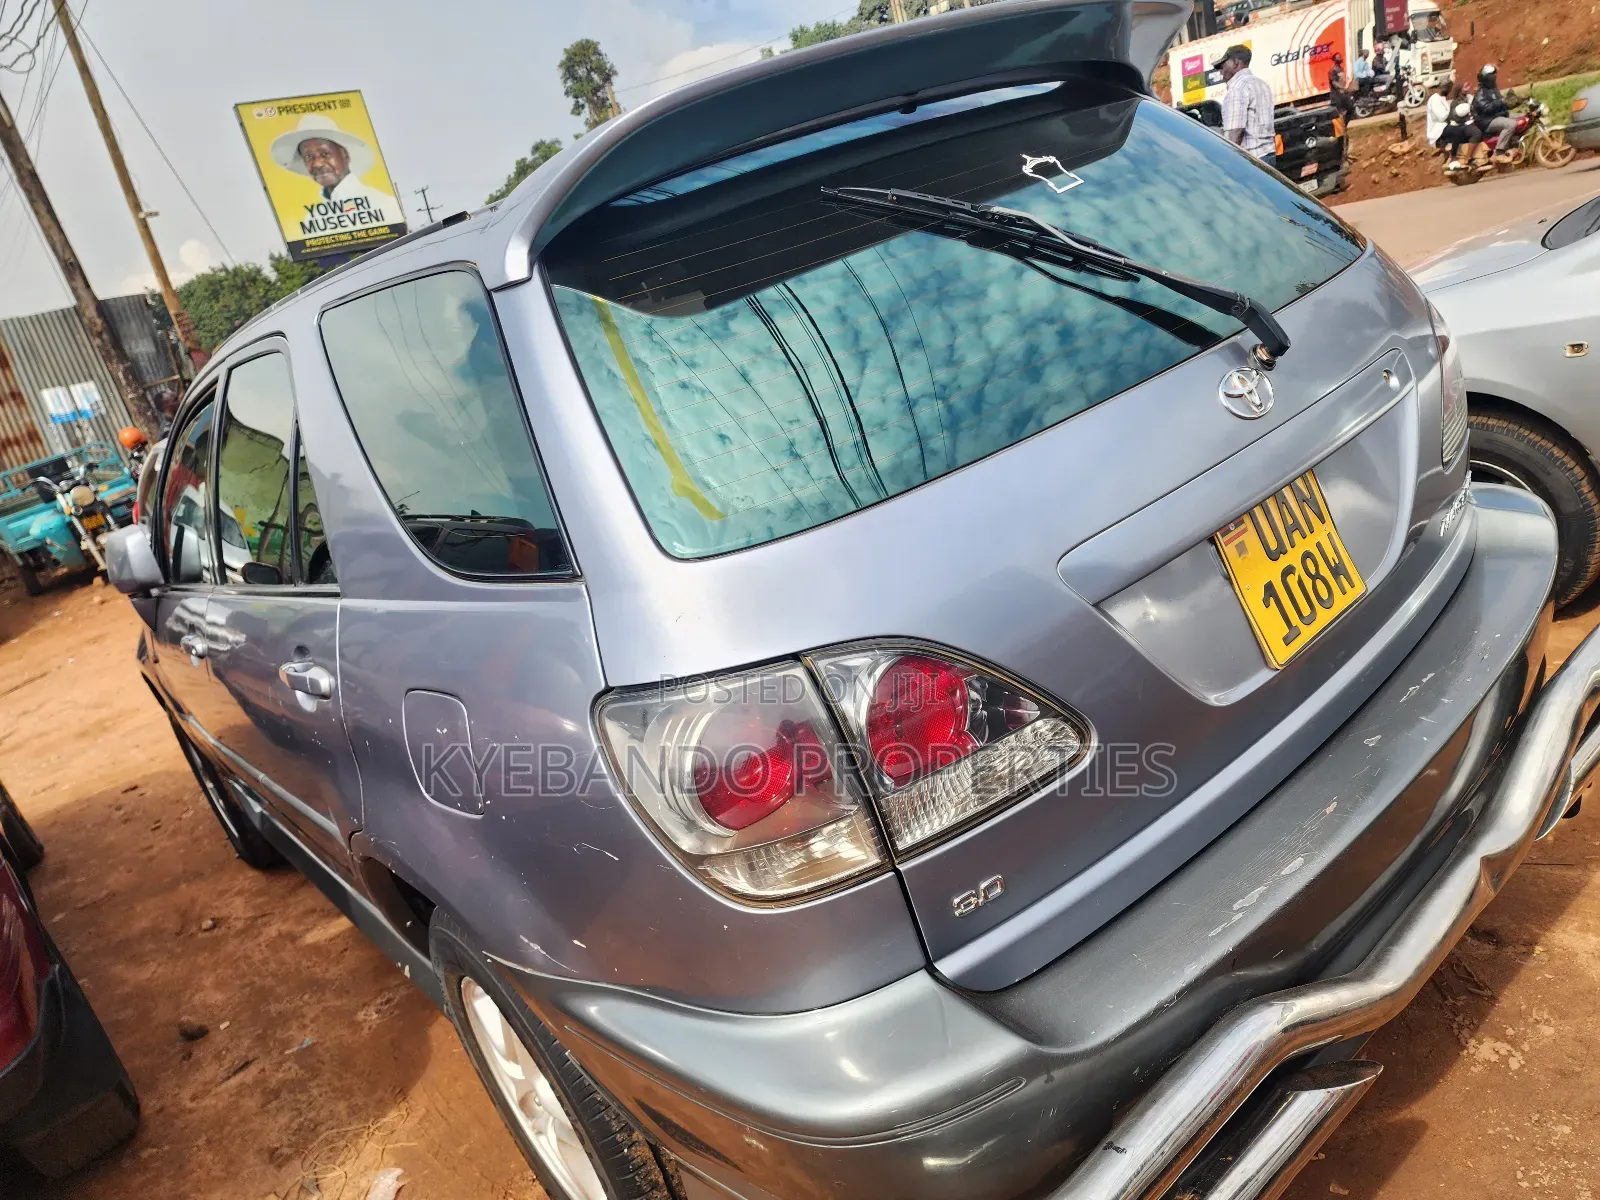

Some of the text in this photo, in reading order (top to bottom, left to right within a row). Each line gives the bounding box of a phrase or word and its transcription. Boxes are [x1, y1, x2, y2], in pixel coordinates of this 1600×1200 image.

[1270, 47, 1301, 66] Global
[1302, 41, 1334, 58] Paper
[277, 100, 338, 116] PRESIDENT
[299, 209, 385, 235] MUSEVENI
[305, 234, 353, 247] PROTECTING
[353, 230, 368, 239] THE
[1248, 470, 1326, 562] UAN
[1262, 532, 1356, 647] 108W
